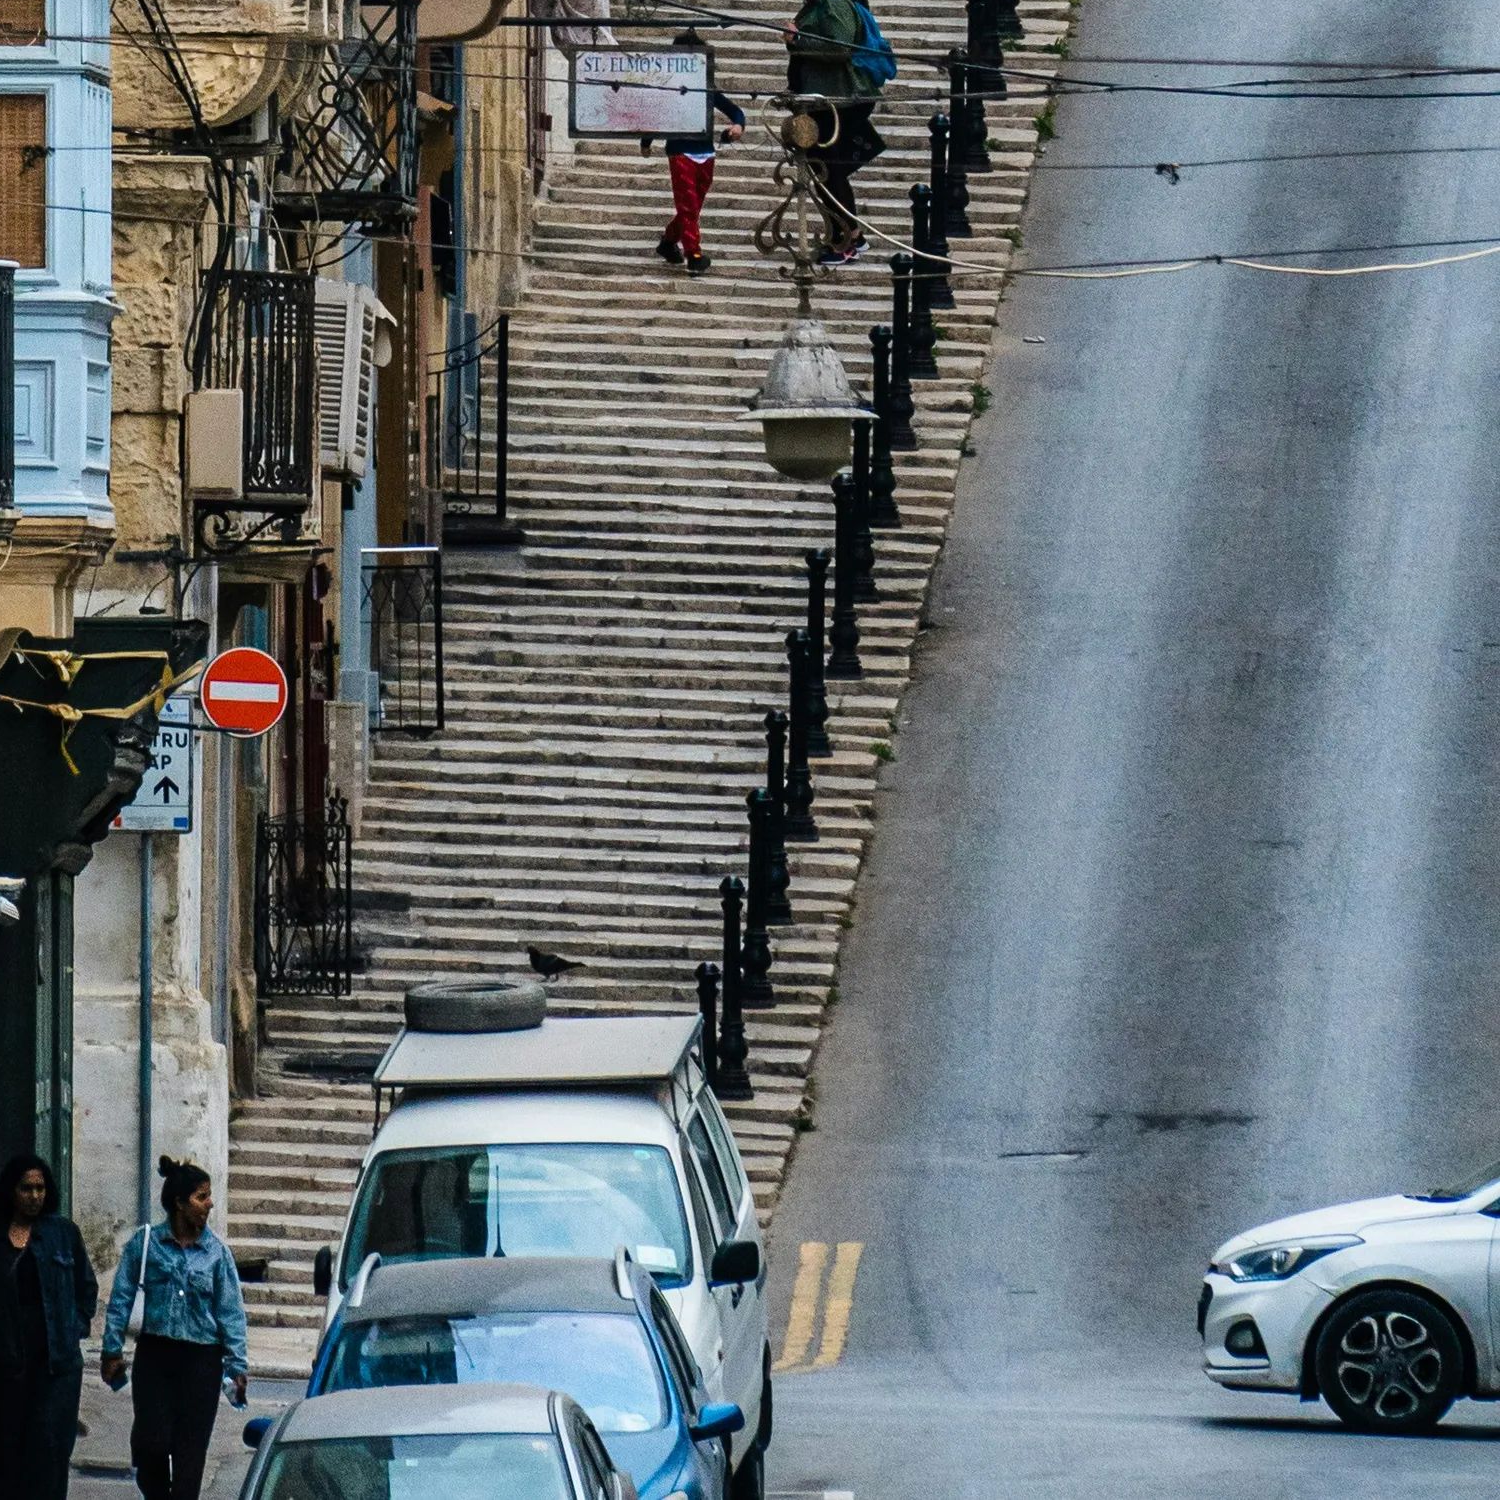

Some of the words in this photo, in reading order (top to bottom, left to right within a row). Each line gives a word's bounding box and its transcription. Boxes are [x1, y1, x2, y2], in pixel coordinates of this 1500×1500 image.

[584, 56, 606, 73] ST.
[610, 56, 662, 73] ELMO'S
[667, 56, 699, 74] FIRE
